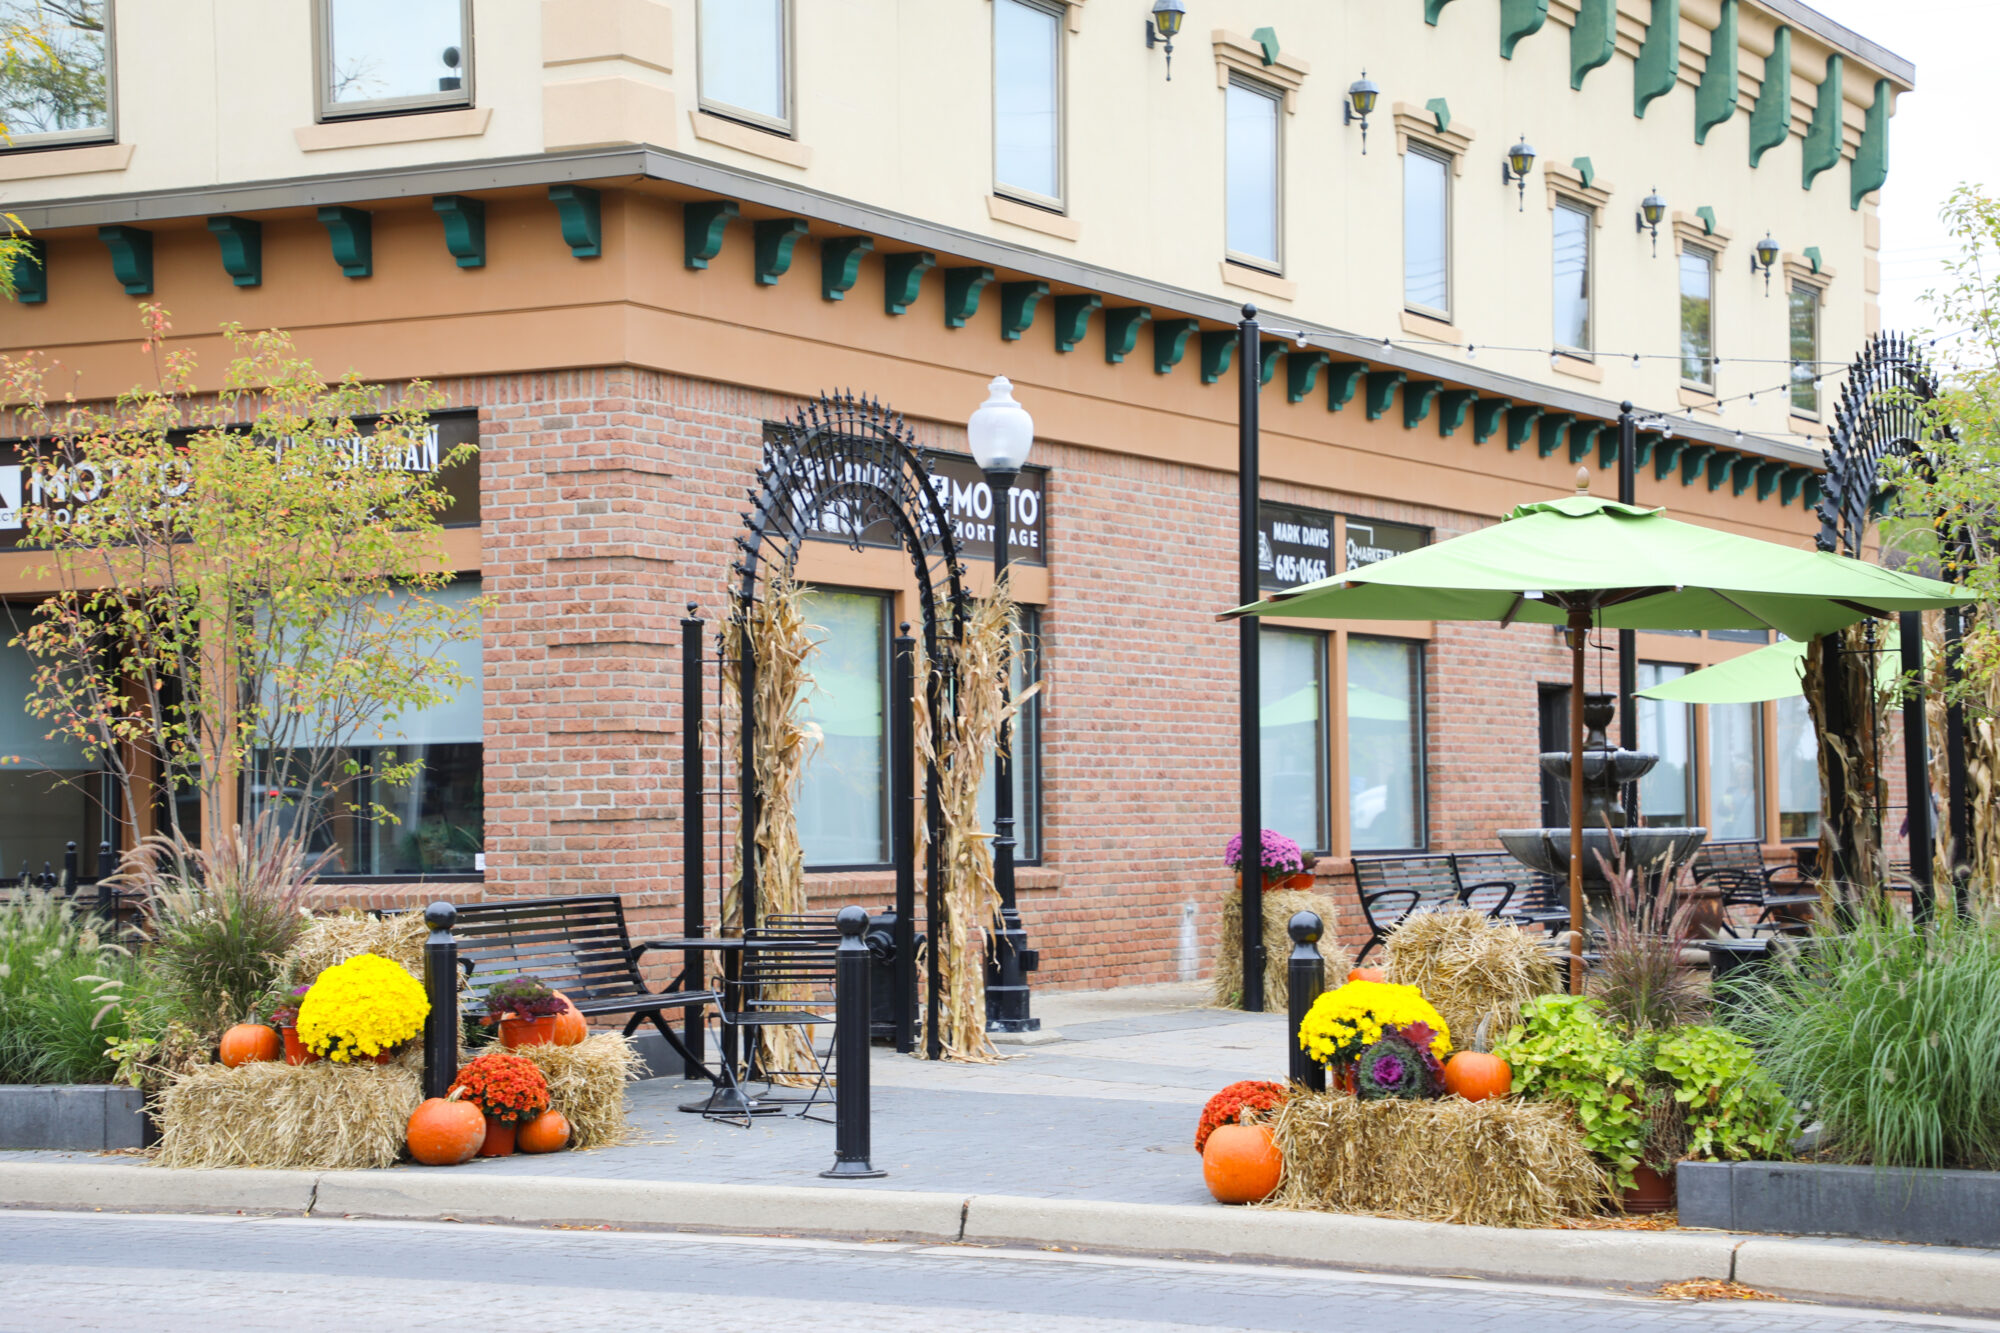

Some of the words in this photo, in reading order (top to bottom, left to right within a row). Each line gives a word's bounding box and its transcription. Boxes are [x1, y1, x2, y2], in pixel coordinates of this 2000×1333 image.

[953, 479, 1038, 526] MOTO
[953, 521, 1039, 548] MORTAGE
[1273, 522, 1300, 543] MARK
[1302, 526, 1329, 548] DAVIS
